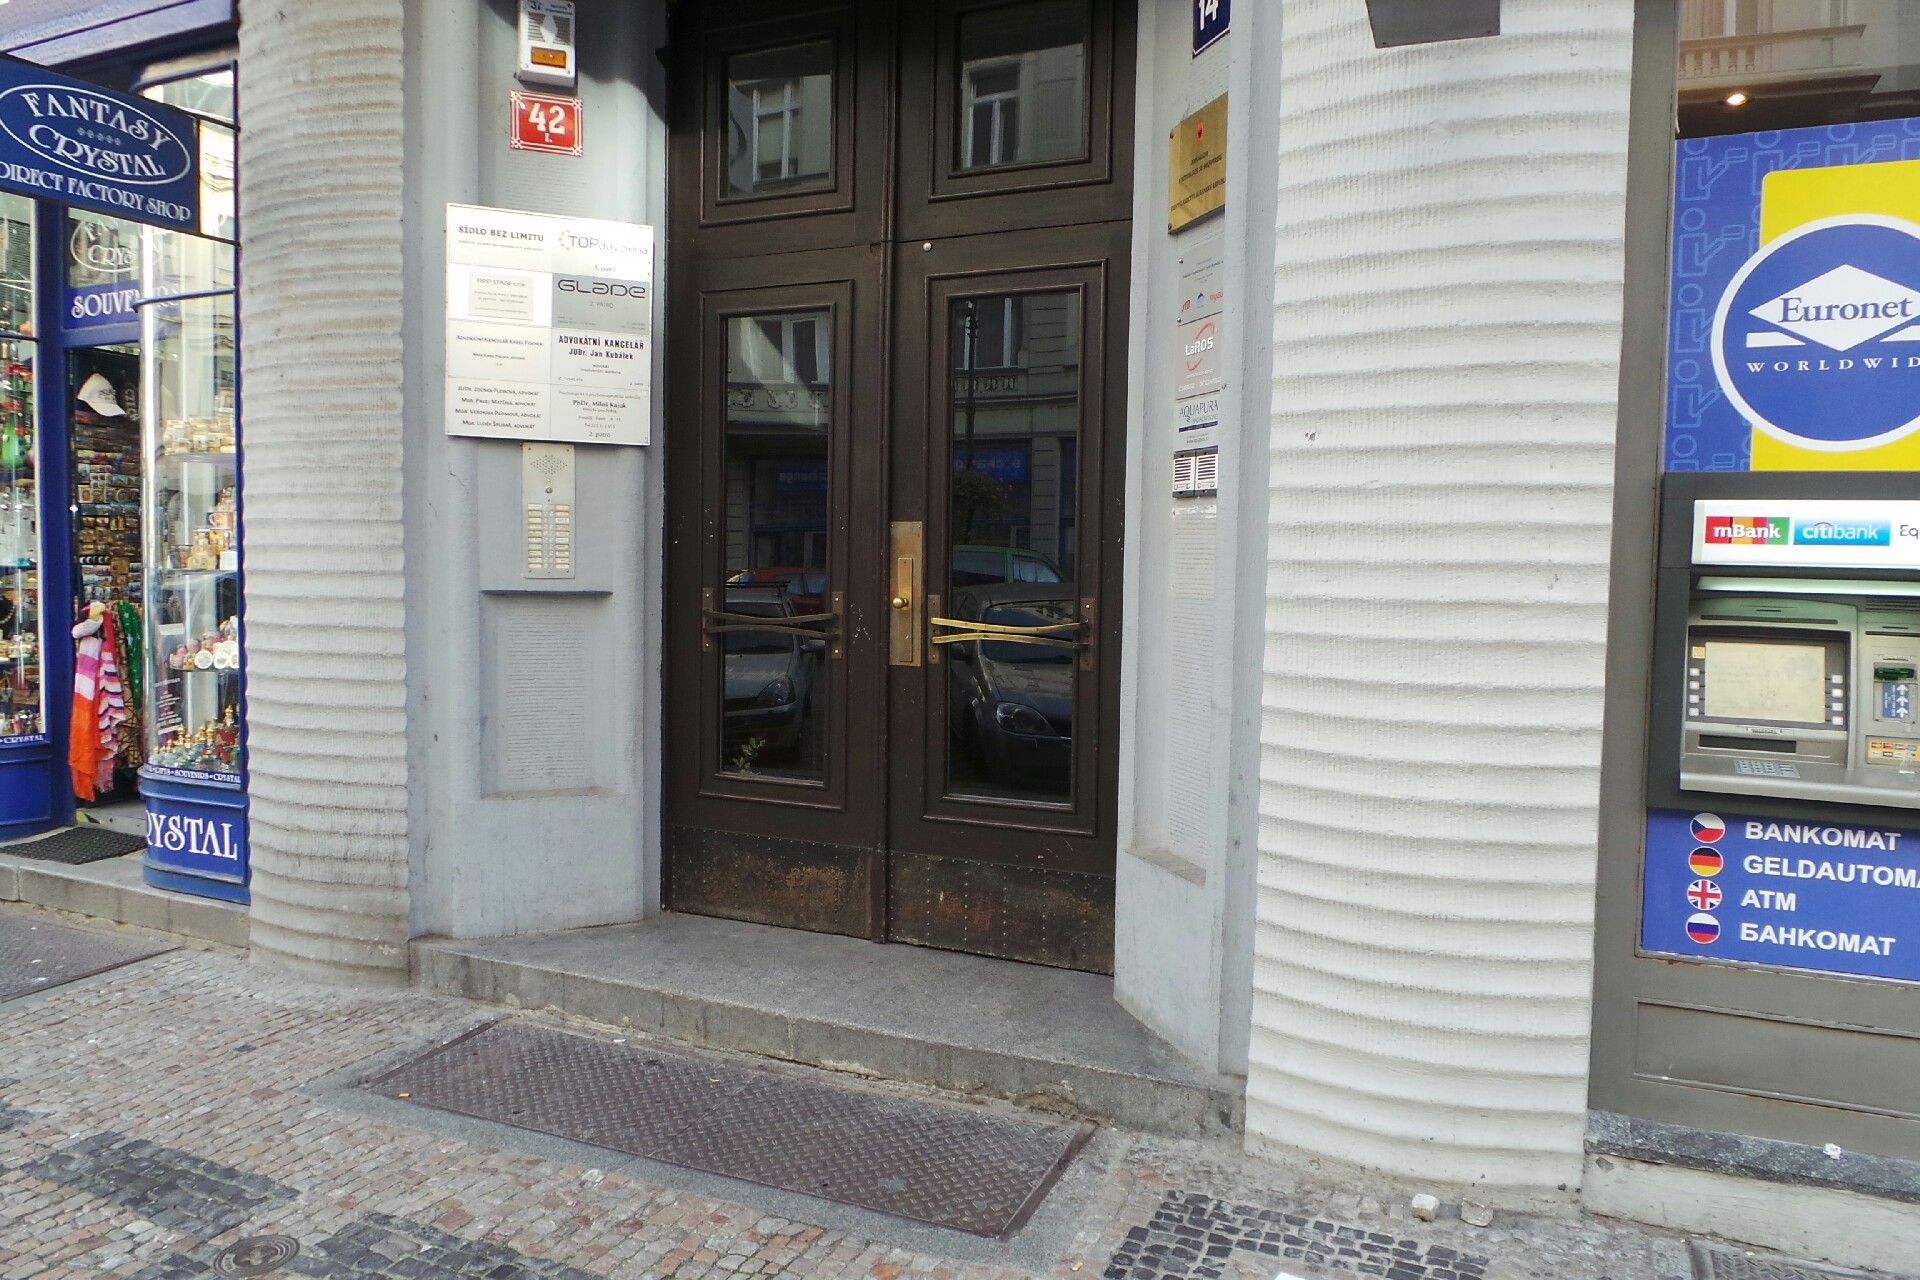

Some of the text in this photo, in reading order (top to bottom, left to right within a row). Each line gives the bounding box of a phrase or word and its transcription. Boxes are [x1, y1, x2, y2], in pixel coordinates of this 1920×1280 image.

[21, 92, 172, 150] FANTASY
[529, 103, 566, 134] 42
[28, 124, 166, 177] CRYSTAL
[67, 177, 144, 211] FACTORY
[145, 197, 192, 222] SHOP
[458, 225, 544, 242] SÍDLO BEZ LIMITU
[1778, 297, 1912, 323] Euronet
[558, 335, 645, 350] ADVOKÁTNÍ KANCELÁŘ
[569, 348, 588, 356] JUDr.
[606, 351, 634, 360] Kubálek
[1185, 337, 1214, 357] LaROS
[1713, 524, 1781, 539] mBank
[1803, 522, 1878, 540] citibank
[1745, 822, 1901, 850] BANKOMAT
[1743, 855, 1920, 889] GELDAUTOM
[1741, 889, 1796, 911] ATM
[1740, 922, 1896, 955] БАНКОМАТ
